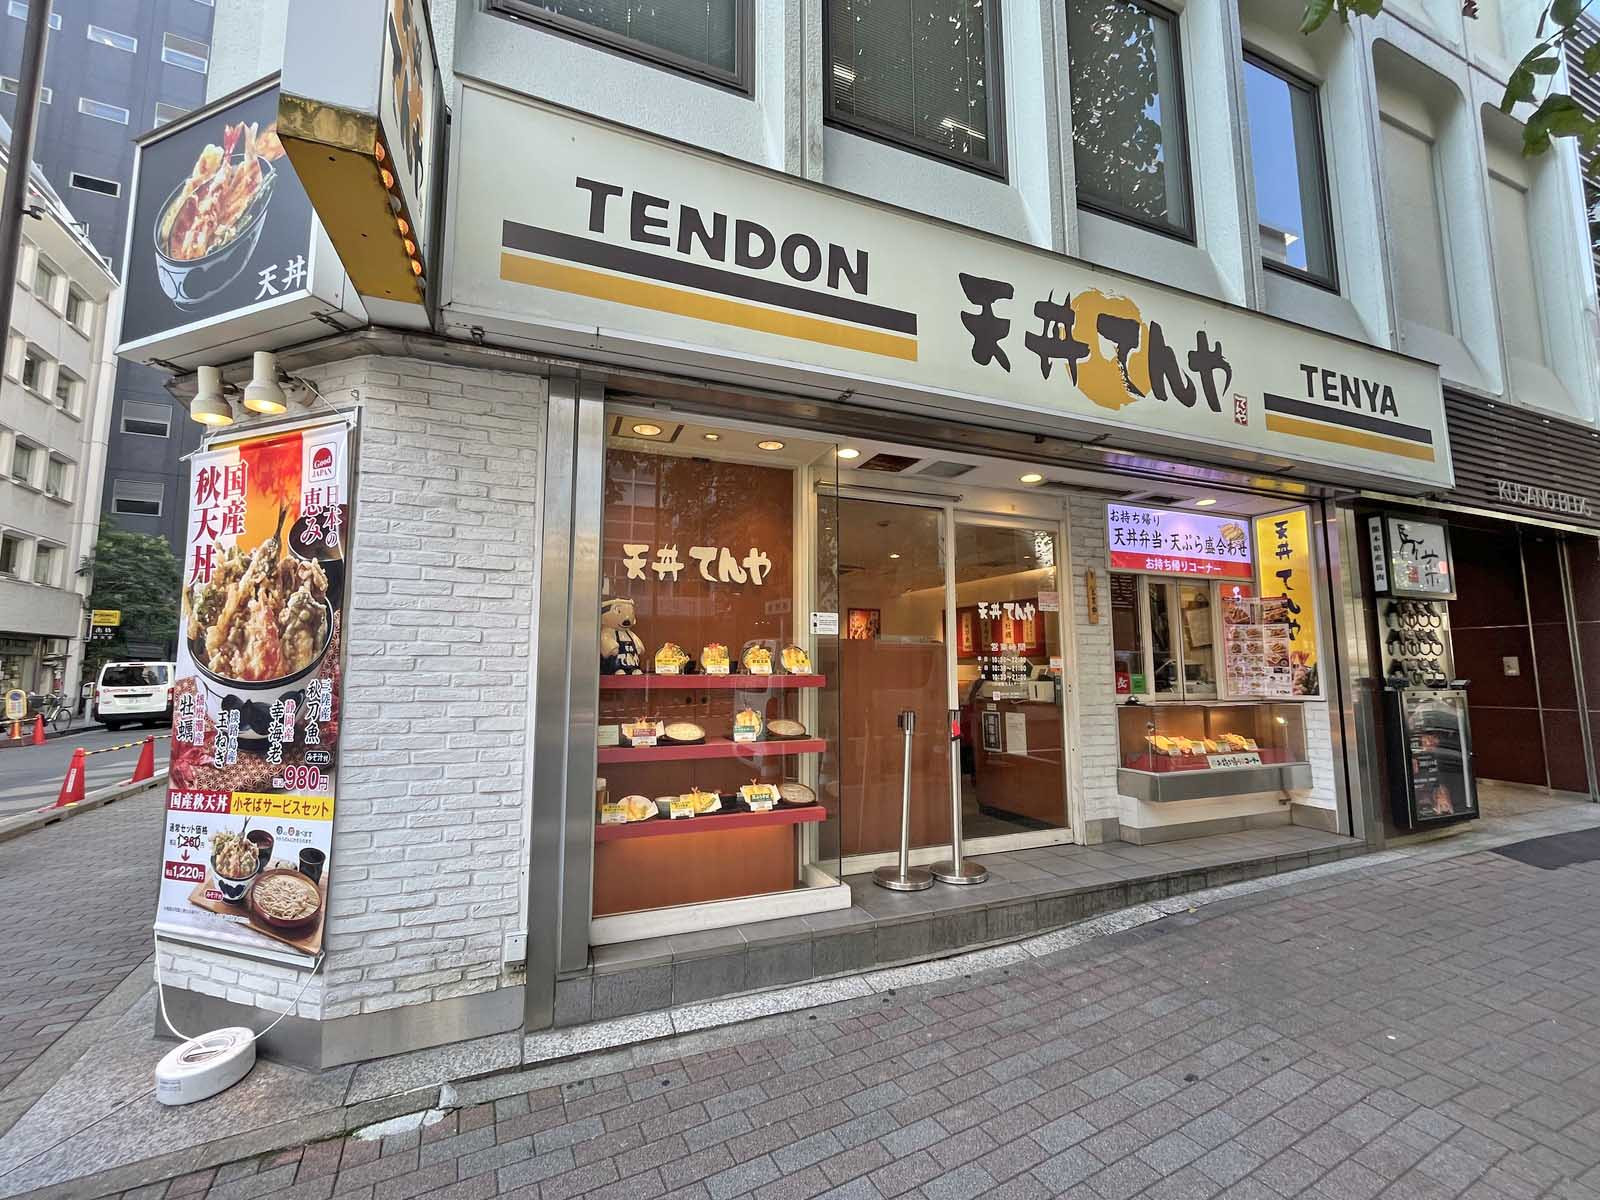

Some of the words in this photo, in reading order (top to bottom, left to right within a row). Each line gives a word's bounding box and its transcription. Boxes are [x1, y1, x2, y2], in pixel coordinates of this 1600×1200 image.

[575, 176, 870, 296] TENDON
[255, 254, 308, 301] 天丼
[1299, 363, 1400, 417] TENYA
[312, 468, 333, 479] JAPAN
[314, 455, 332, 469] Good
[219, 460, 248, 537] 国産
[300, 487, 324, 544] 恵み
[323, 485, 343, 548] 日本の
[1109, 508, 1161, 527] お持ち帰り
[188, 465, 222, 586] 秋天丼
[1113, 527, 1248, 558] 天丼弁当・天ぷら盛合わせ
[1145, 557, 1222, 575] お持ち帰りコーナー
[176, 694, 194, 743] 牡蠣
[282, 698, 296, 743] 静岡産
[304, 679, 322, 745] 秋刀魚
[319, 678, 332, 722] 三陸産
[213, 709, 230, 768] 玉ねぎ
[226, 709, 241, 765] 淡路島産
[265, 700, 285, 766] 幸海老
[169, 791, 229, 814] 国産秋天丼
[233, 797, 330, 817] 小そばサービスセット
[169, 822, 208, 835] 通常セット価格
